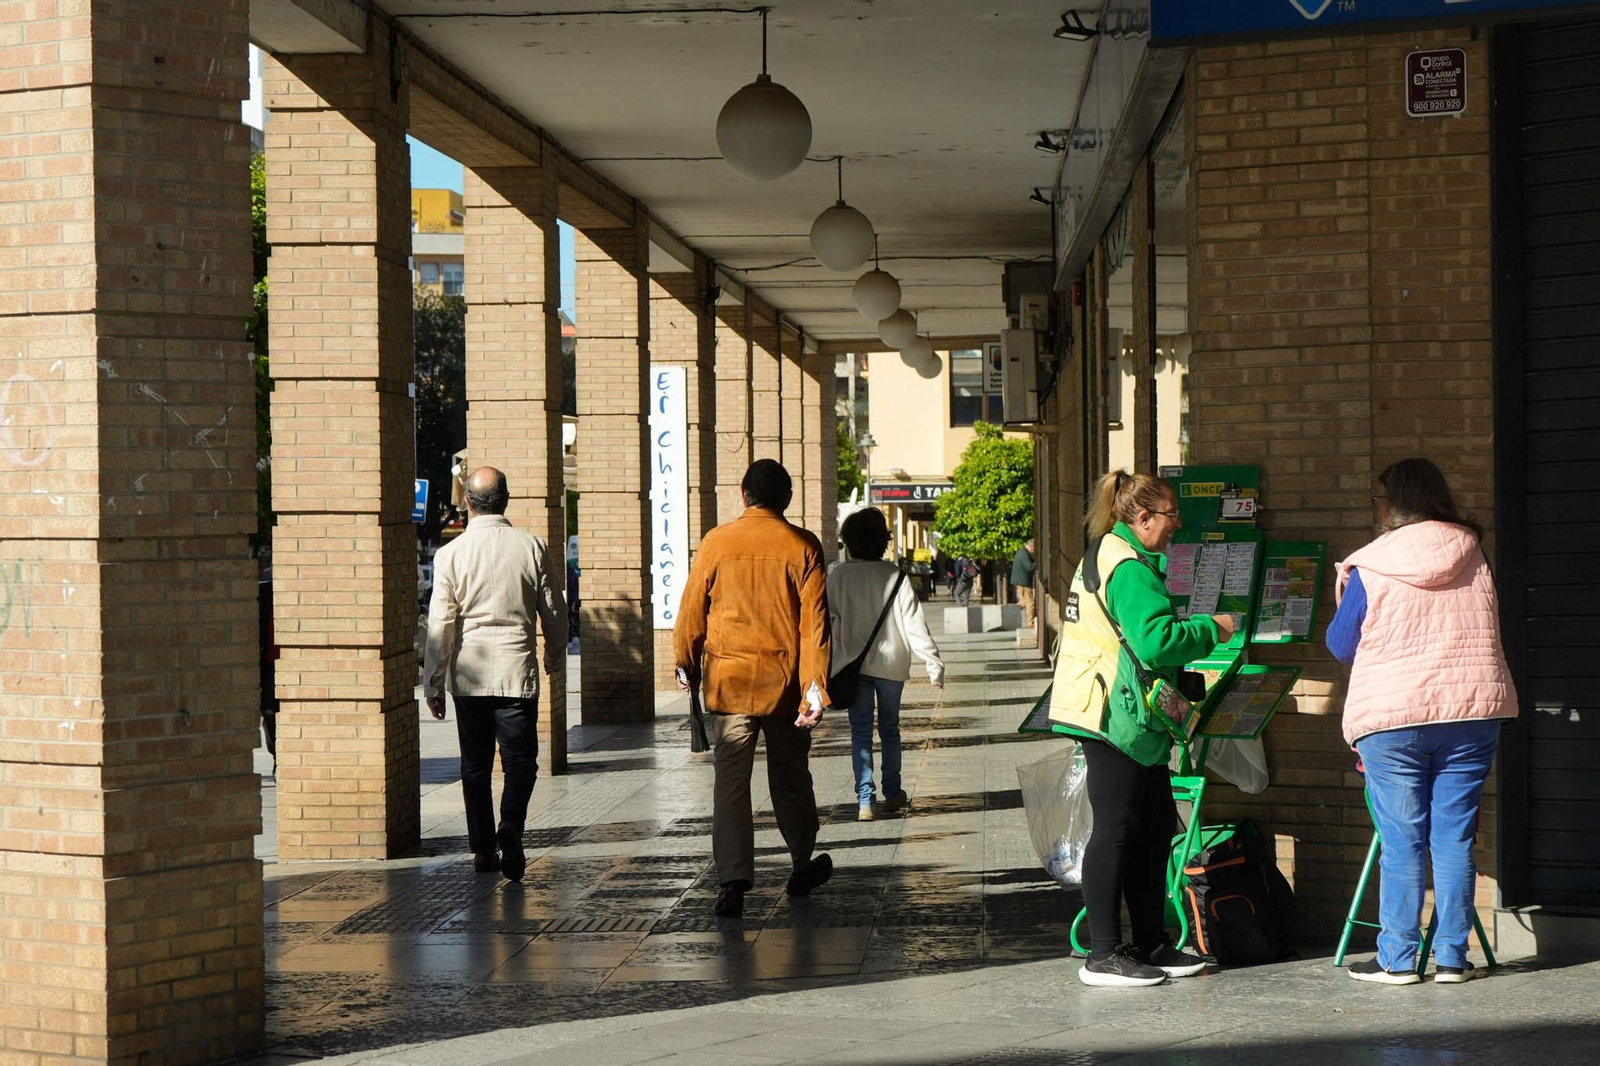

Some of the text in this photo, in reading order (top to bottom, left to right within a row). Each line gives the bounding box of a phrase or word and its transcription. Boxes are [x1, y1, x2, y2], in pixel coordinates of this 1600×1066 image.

[1337, 1, 1356, 12] TM
[1431, 60, 1452, 68] control
[1425, 70, 1457, 80] ALARMA
[1425, 77, 1457, 85] CONECTADA
[1413, 100, 1461, 111] 900 920 920
[1193, 485, 1222, 494] ONCE
[1236, 501, 1252, 512] 75
